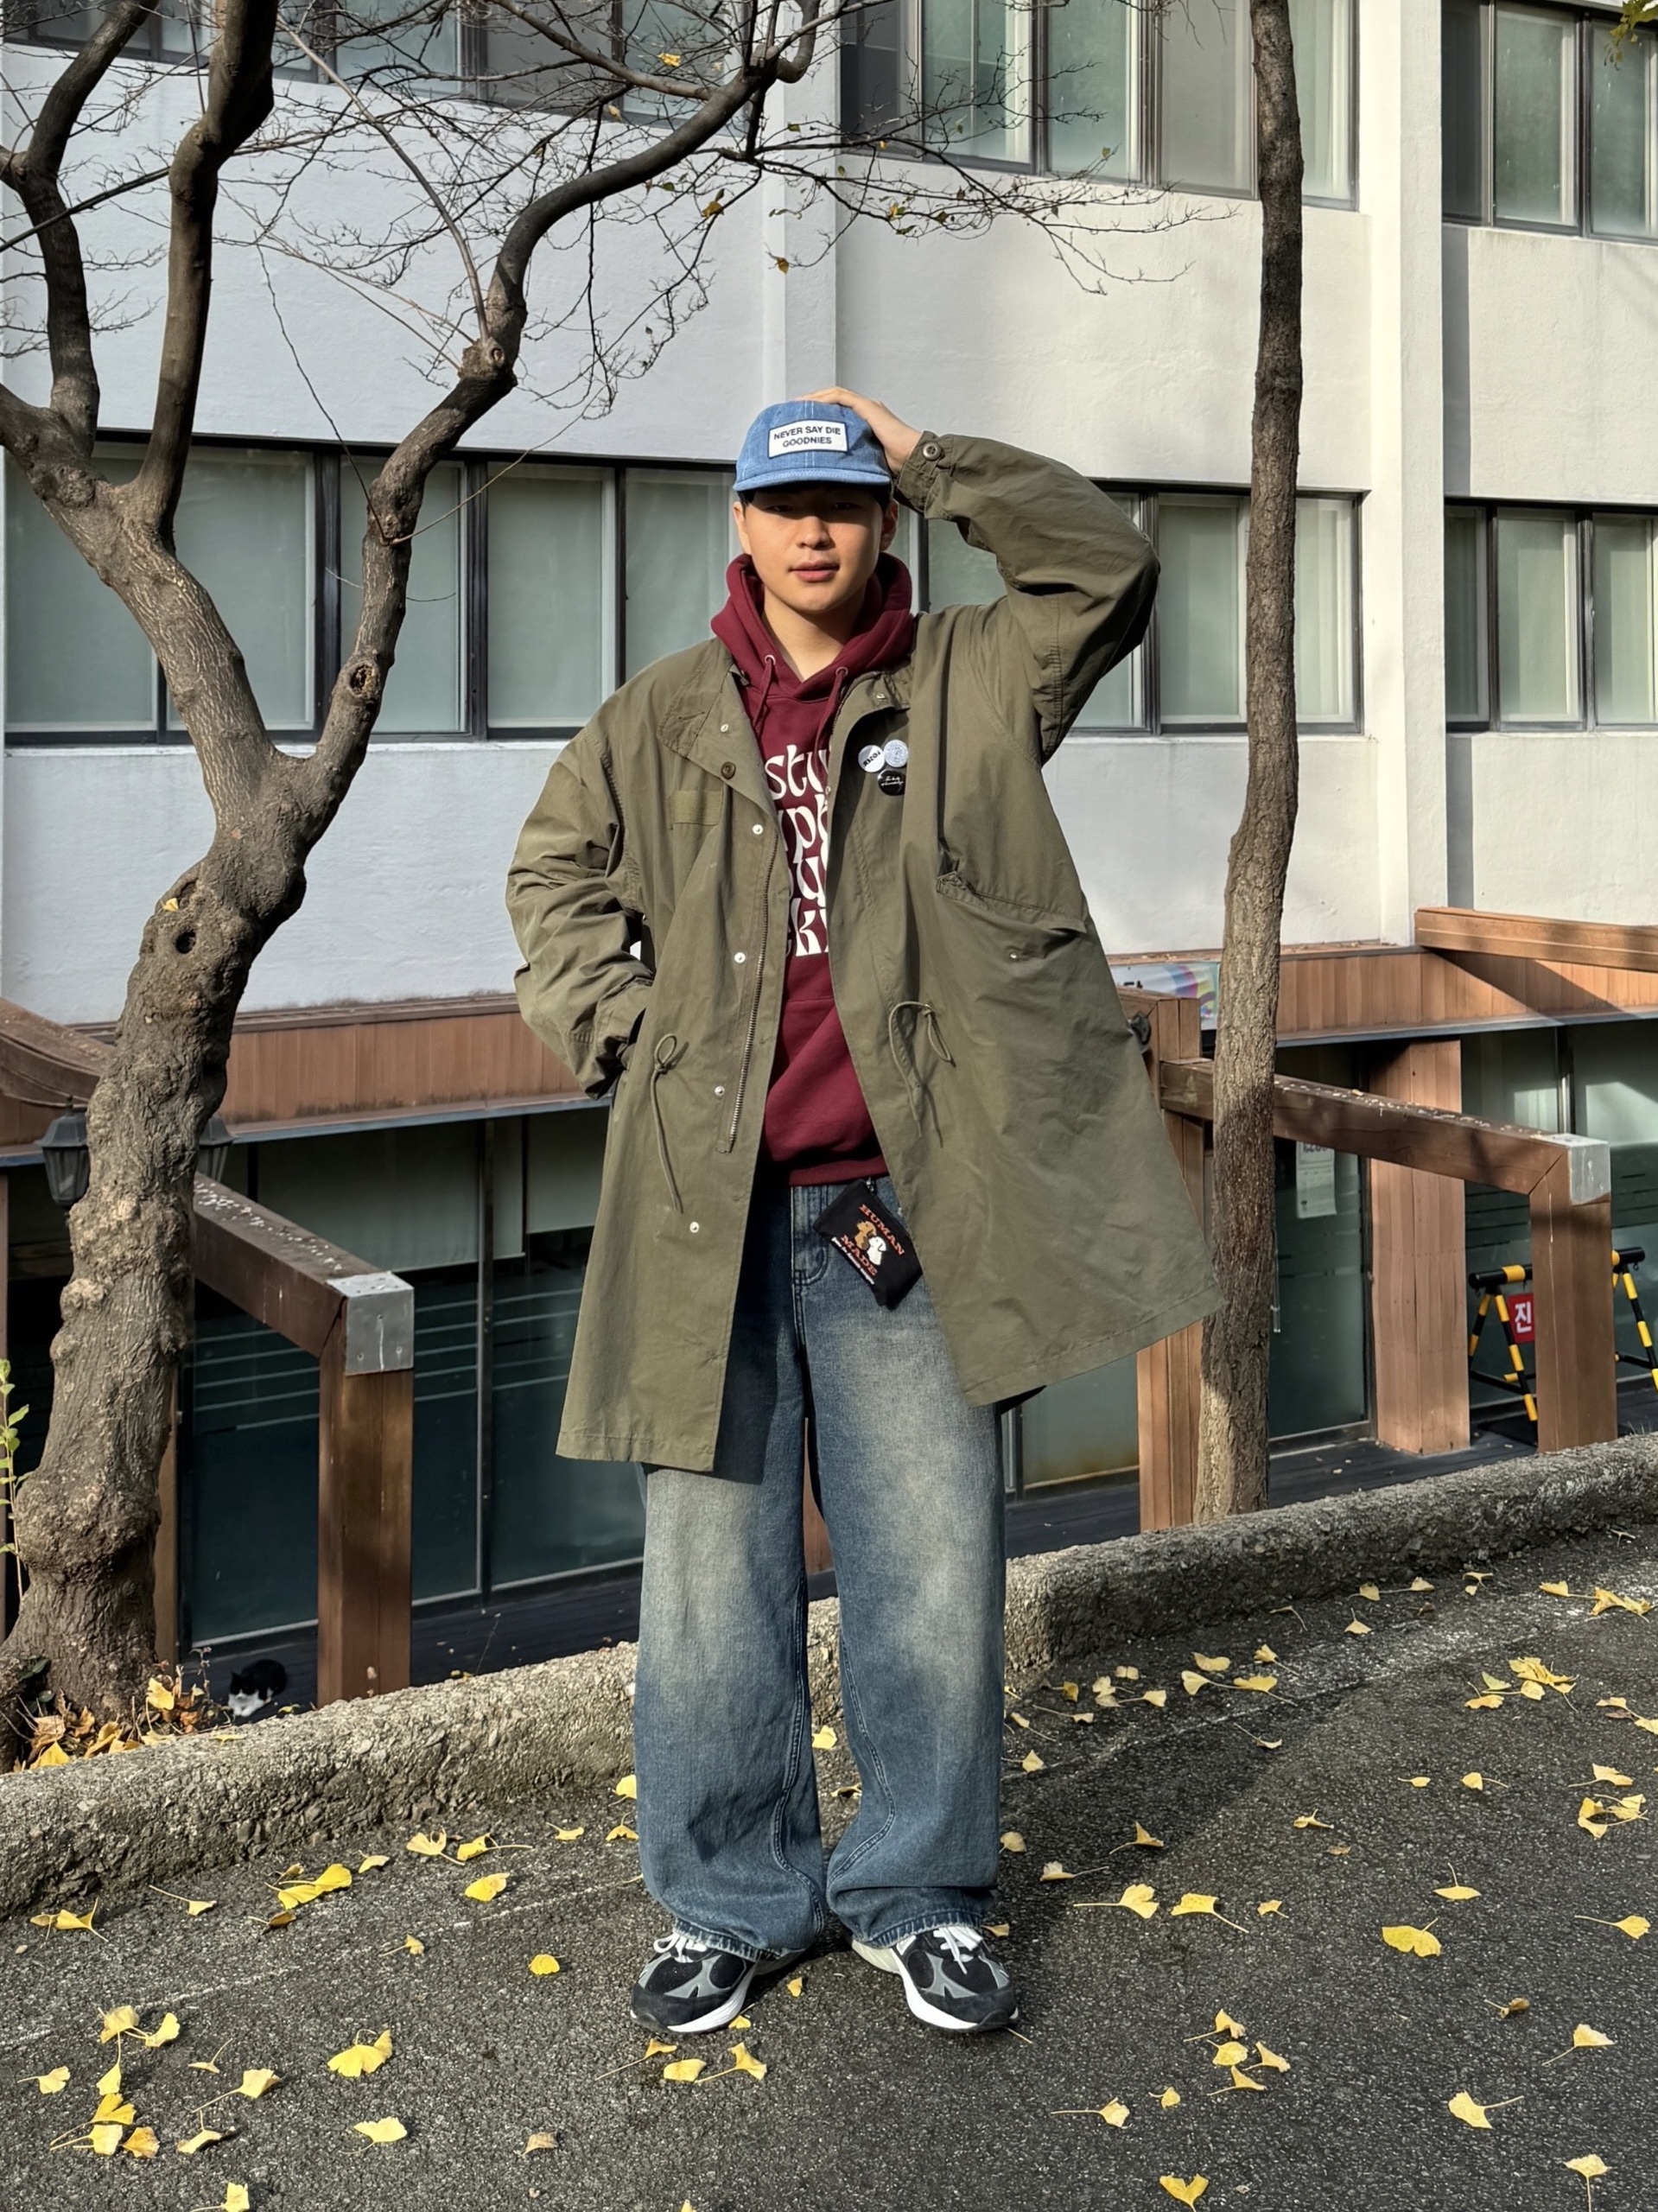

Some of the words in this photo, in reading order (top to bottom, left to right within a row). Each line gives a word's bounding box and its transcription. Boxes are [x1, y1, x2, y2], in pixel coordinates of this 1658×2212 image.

[774, 428, 803, 439] NEVER
[783, 436, 832, 448] GOODNIES
[860, 1204, 905, 1255] HUMAN
[841, 1235, 877, 1275] MADE
[1515, 1302, 1532, 1333] 진
